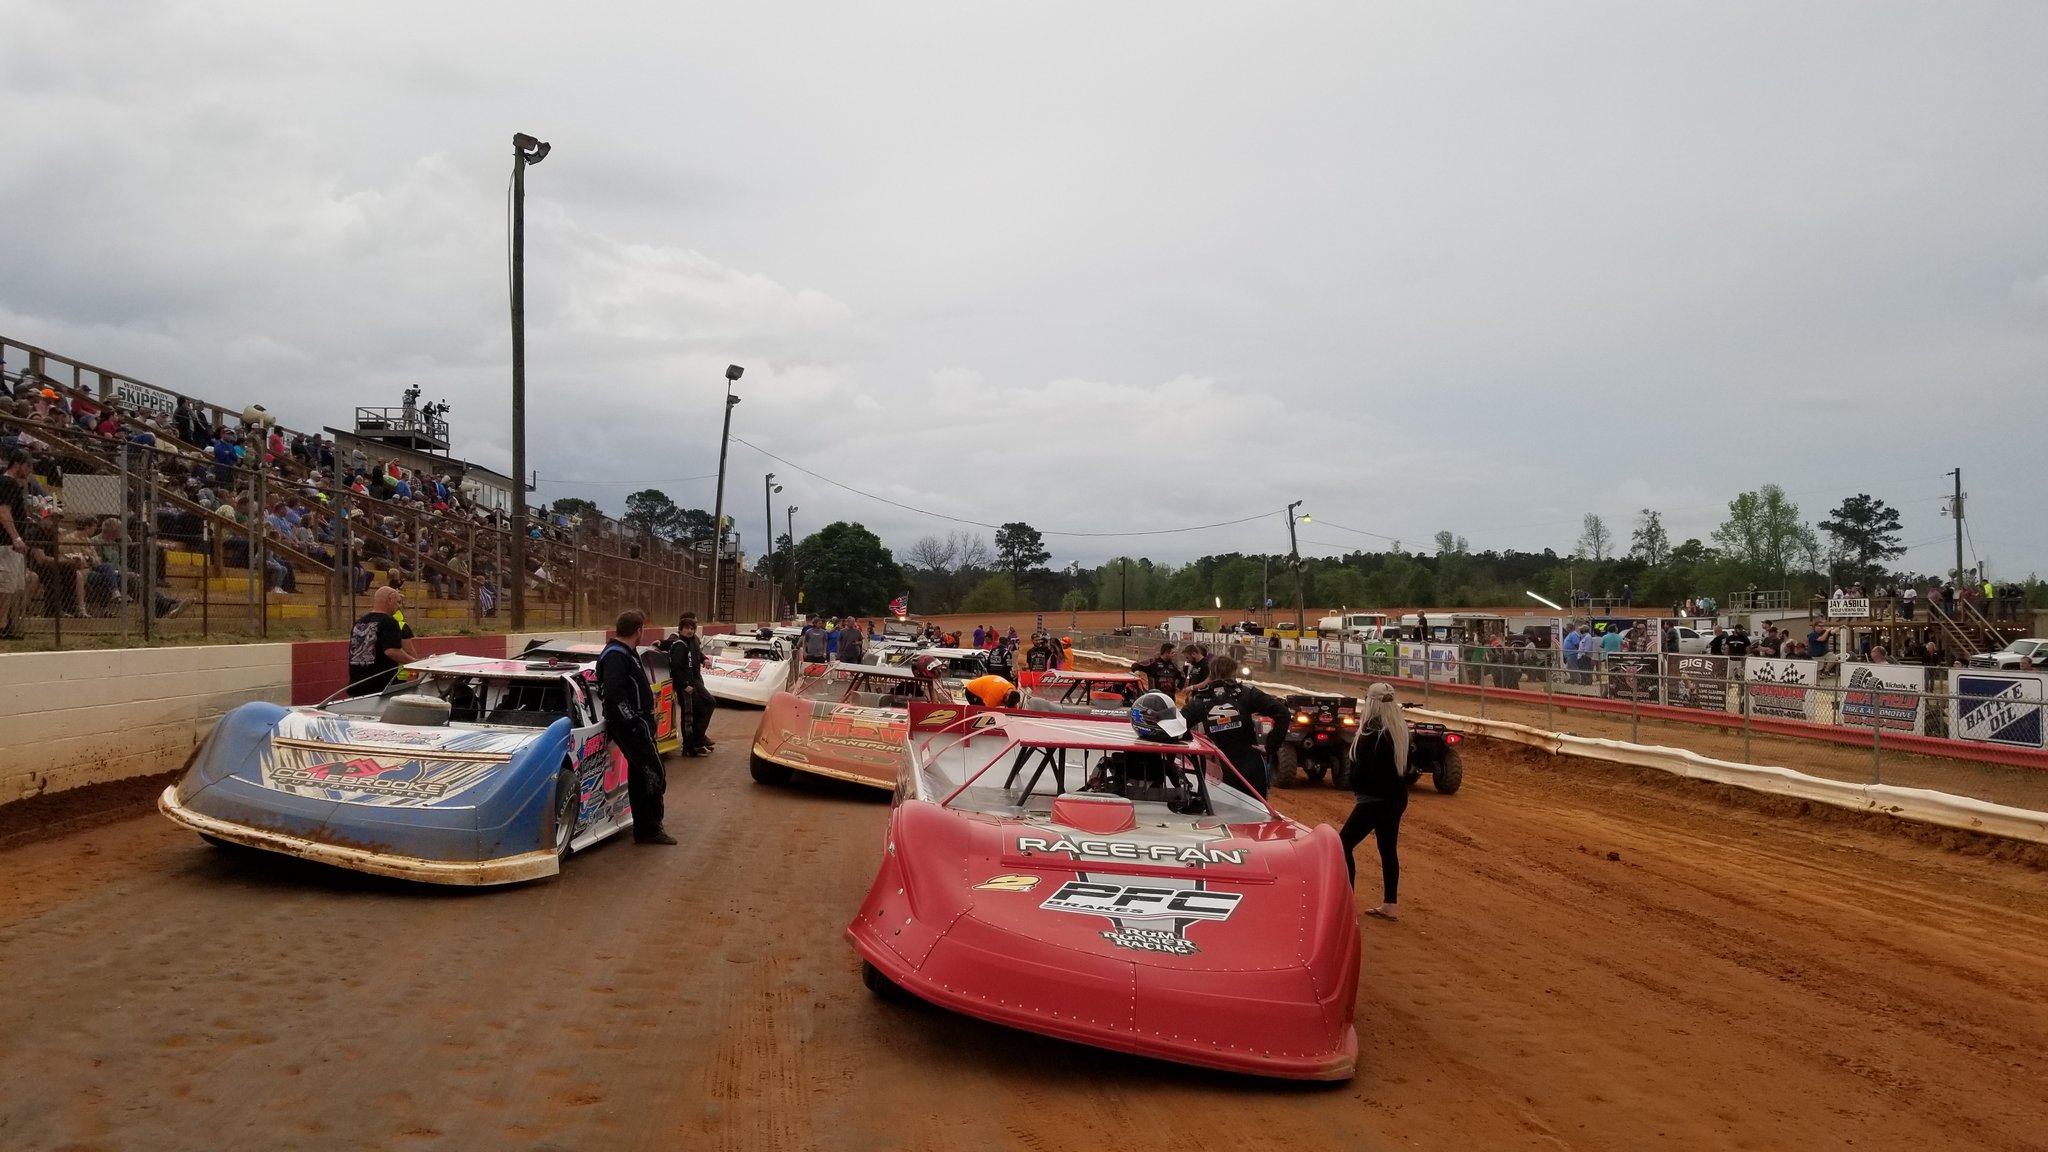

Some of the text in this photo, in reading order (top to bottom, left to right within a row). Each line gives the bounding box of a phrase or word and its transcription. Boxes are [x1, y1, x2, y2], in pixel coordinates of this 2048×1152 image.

[117, 386, 174, 414] SKIPPER
[1829, 599, 1868, 608] JAY ASBILL
[1679, 658, 1703, 670] BIG
[1704, 660, 1714, 672] E
[917, 708, 959, 726] 2
[1989, 707, 2017, 732] OIL
[1209, 721, 1242, 734] SIMPSON
[822, 737, 905, 752] TRANSPORT
[275, 768, 445, 794] COLEBROOKE
[278, 779, 429, 799] CUSTOM HOMES
[972, 873, 1041, 892] 2
[1050, 881, 1242, 914] PFC
[1046, 899, 1145, 914] BRAKES
[1102, 931, 1195, 948] RUNNER
[1122, 927, 1176, 940] RUM
[1115, 938, 1188, 953] RACING
